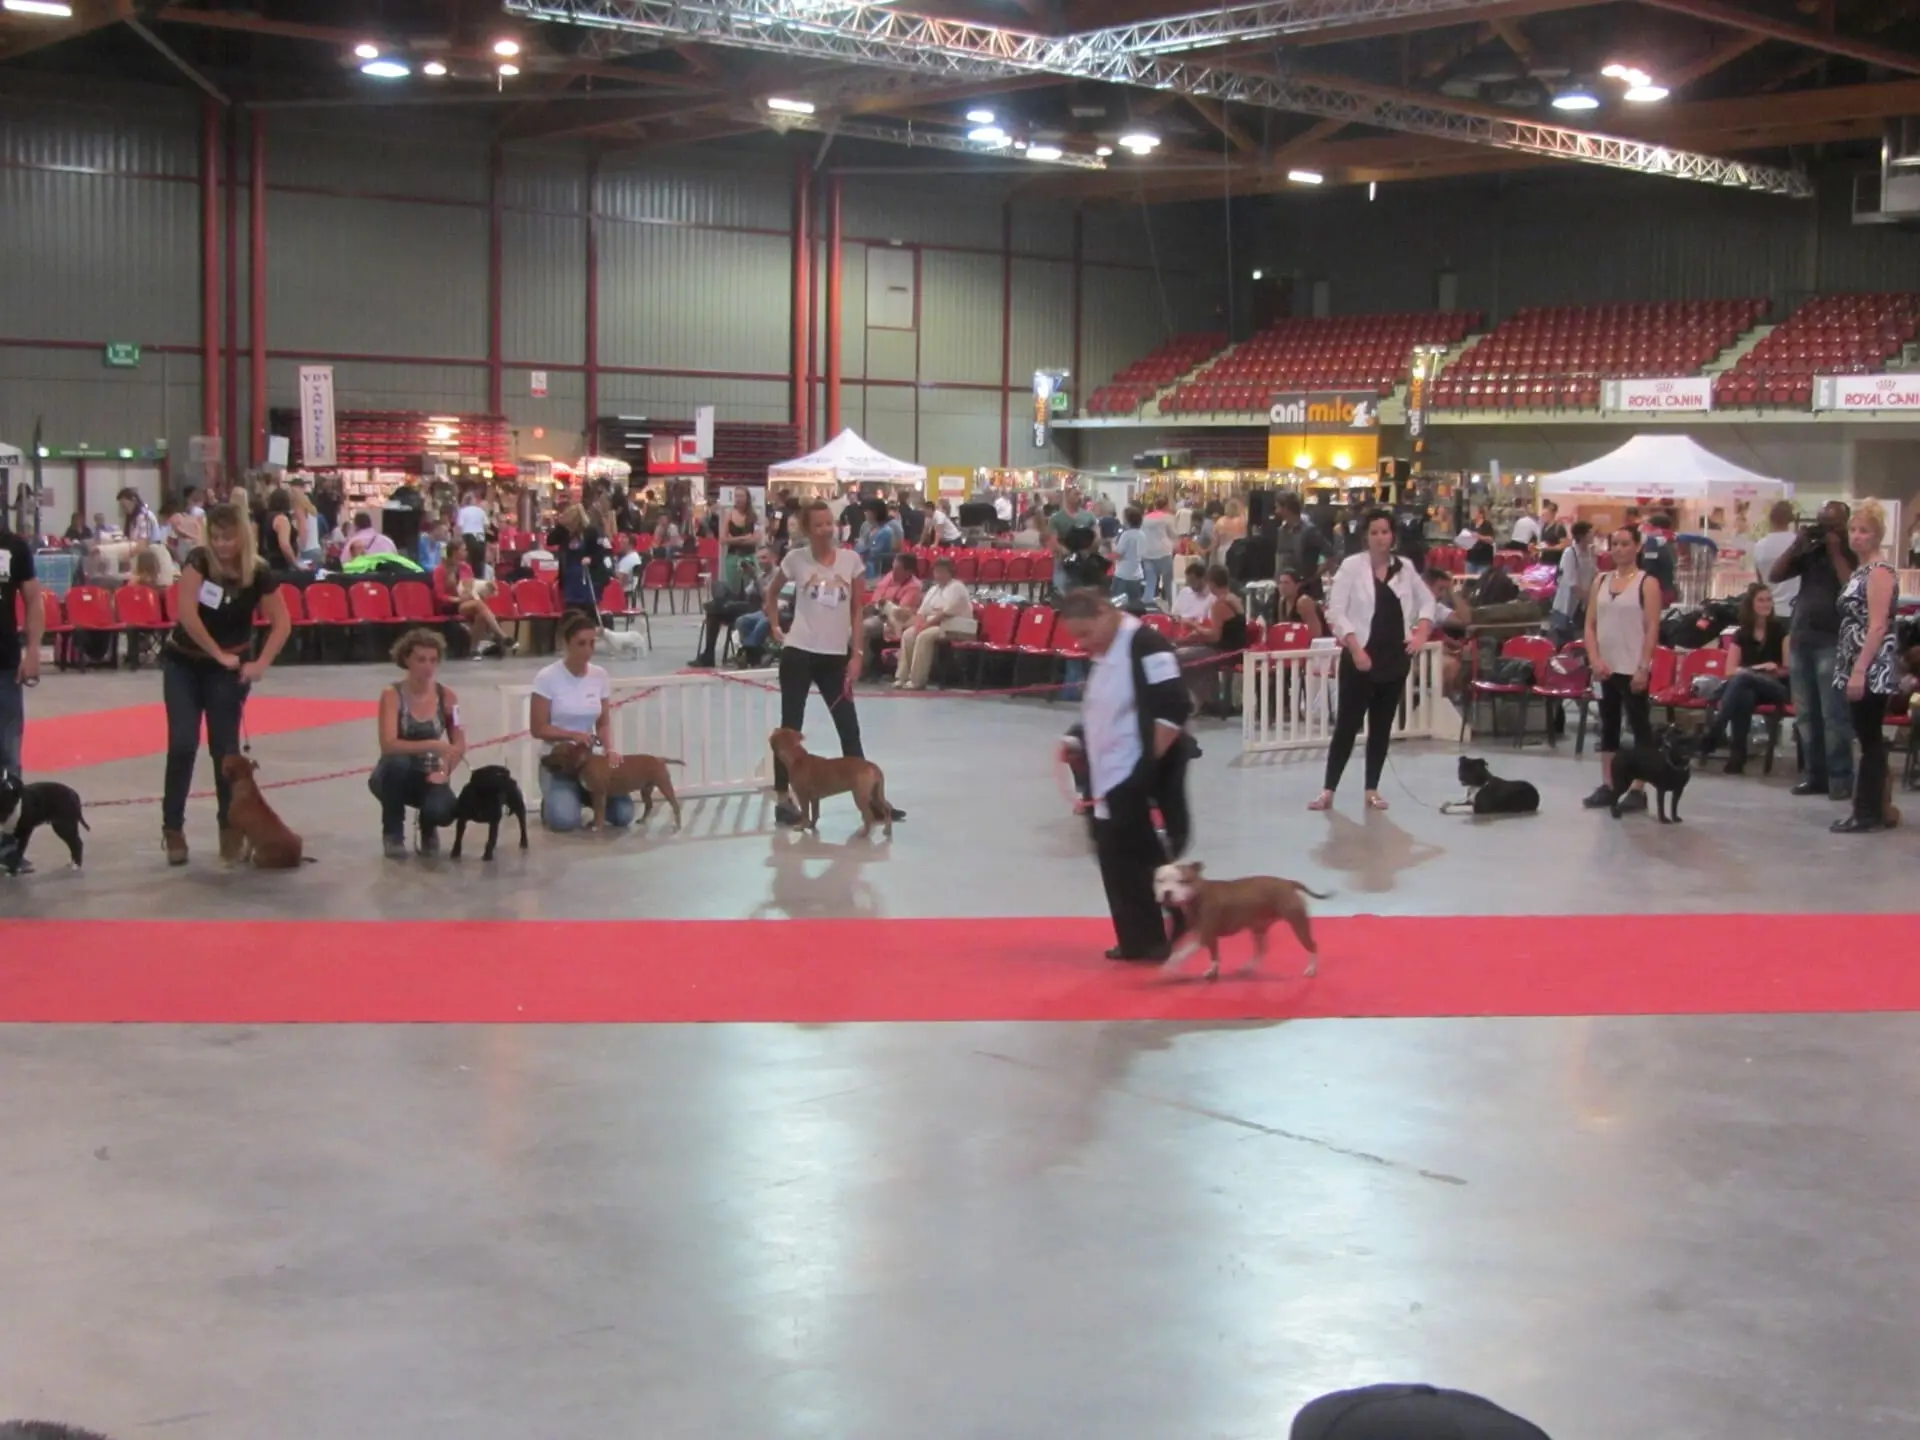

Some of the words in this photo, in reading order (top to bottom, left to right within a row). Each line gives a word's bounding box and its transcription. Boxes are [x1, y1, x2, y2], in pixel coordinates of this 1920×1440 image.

[1628, 395, 1661, 407] ROYAL
[1665, 394, 1703, 407] CANIN
[1844, 393, 1883, 405] ROYAL
[1886, 392, 1920, 405] CANI
